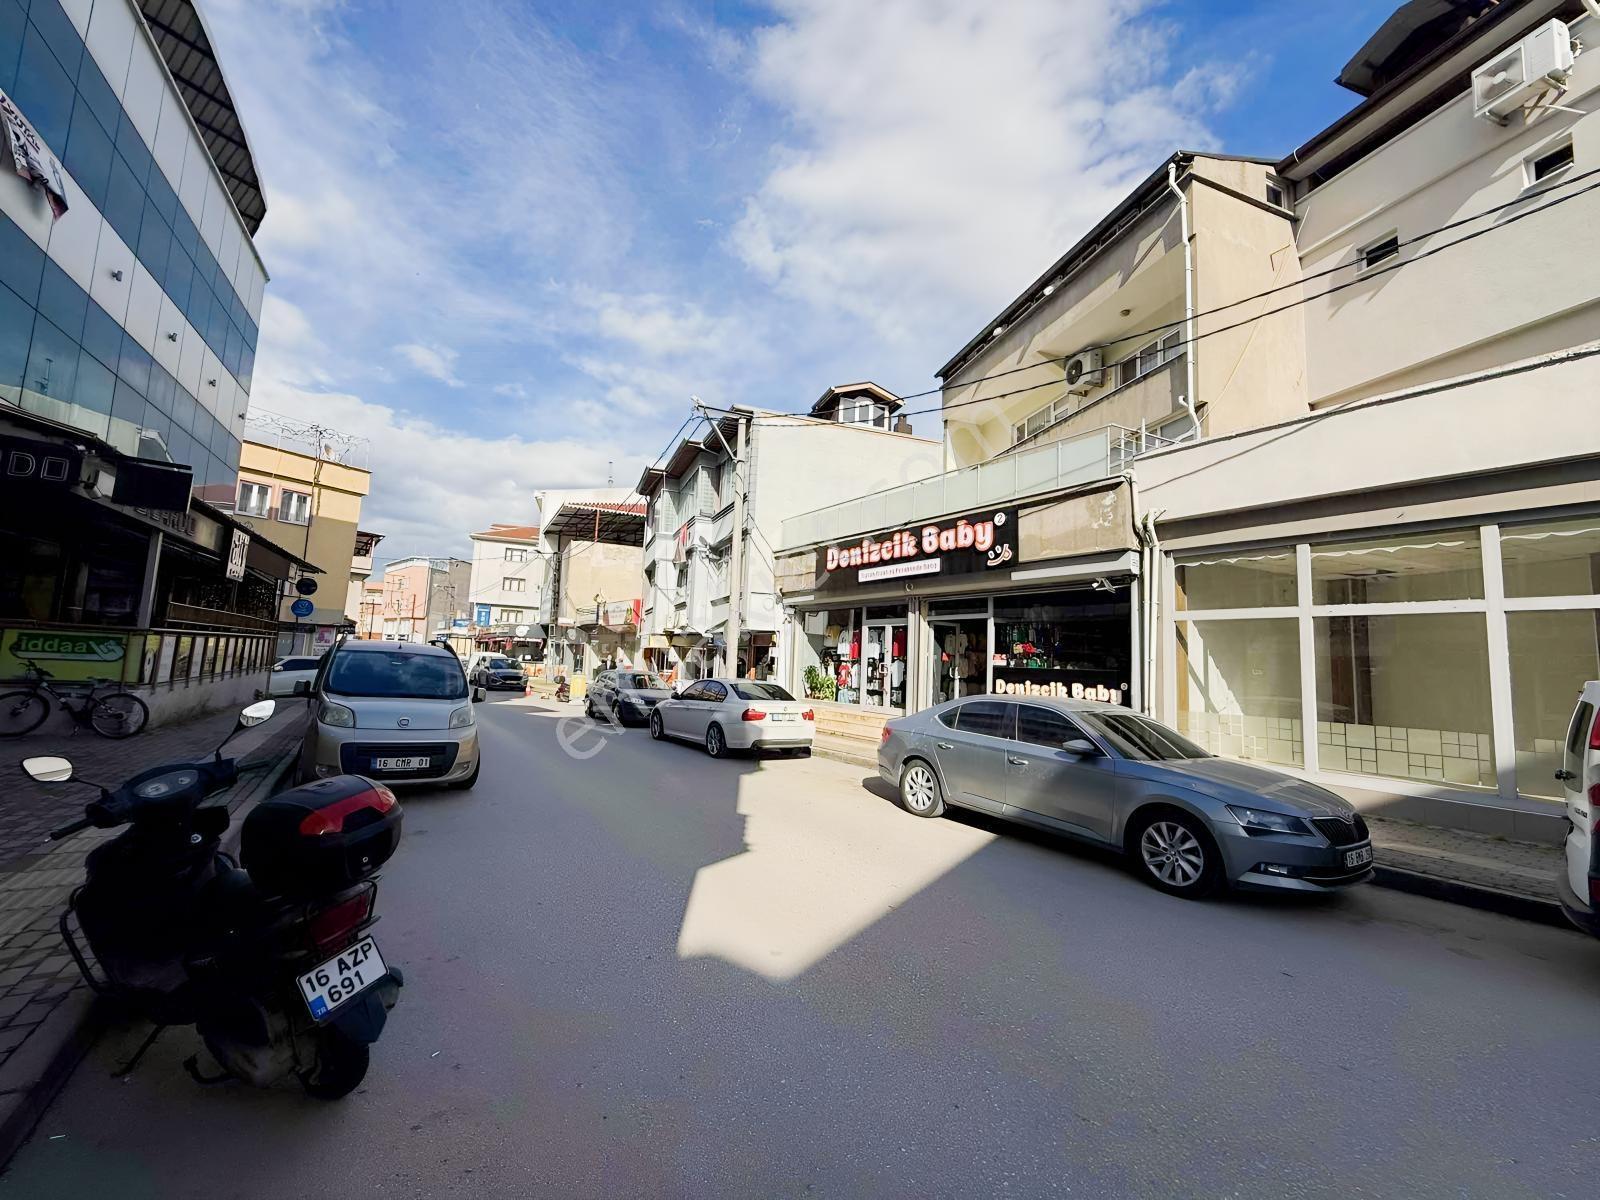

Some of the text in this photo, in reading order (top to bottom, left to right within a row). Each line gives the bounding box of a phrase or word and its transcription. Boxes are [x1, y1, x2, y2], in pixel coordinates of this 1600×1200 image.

[826, 530, 918, 571] Denizcik
[921, 519, 994, 554] Baby
[20, 636, 87, 653] iddaa
[995, 679, 1068, 698] Denizcik
[378, 759, 388, 768] 16
[418, 758, 428, 767] 01
[305, 942, 372, 993] 16 AZP
[327, 970, 364, 1003] 691
